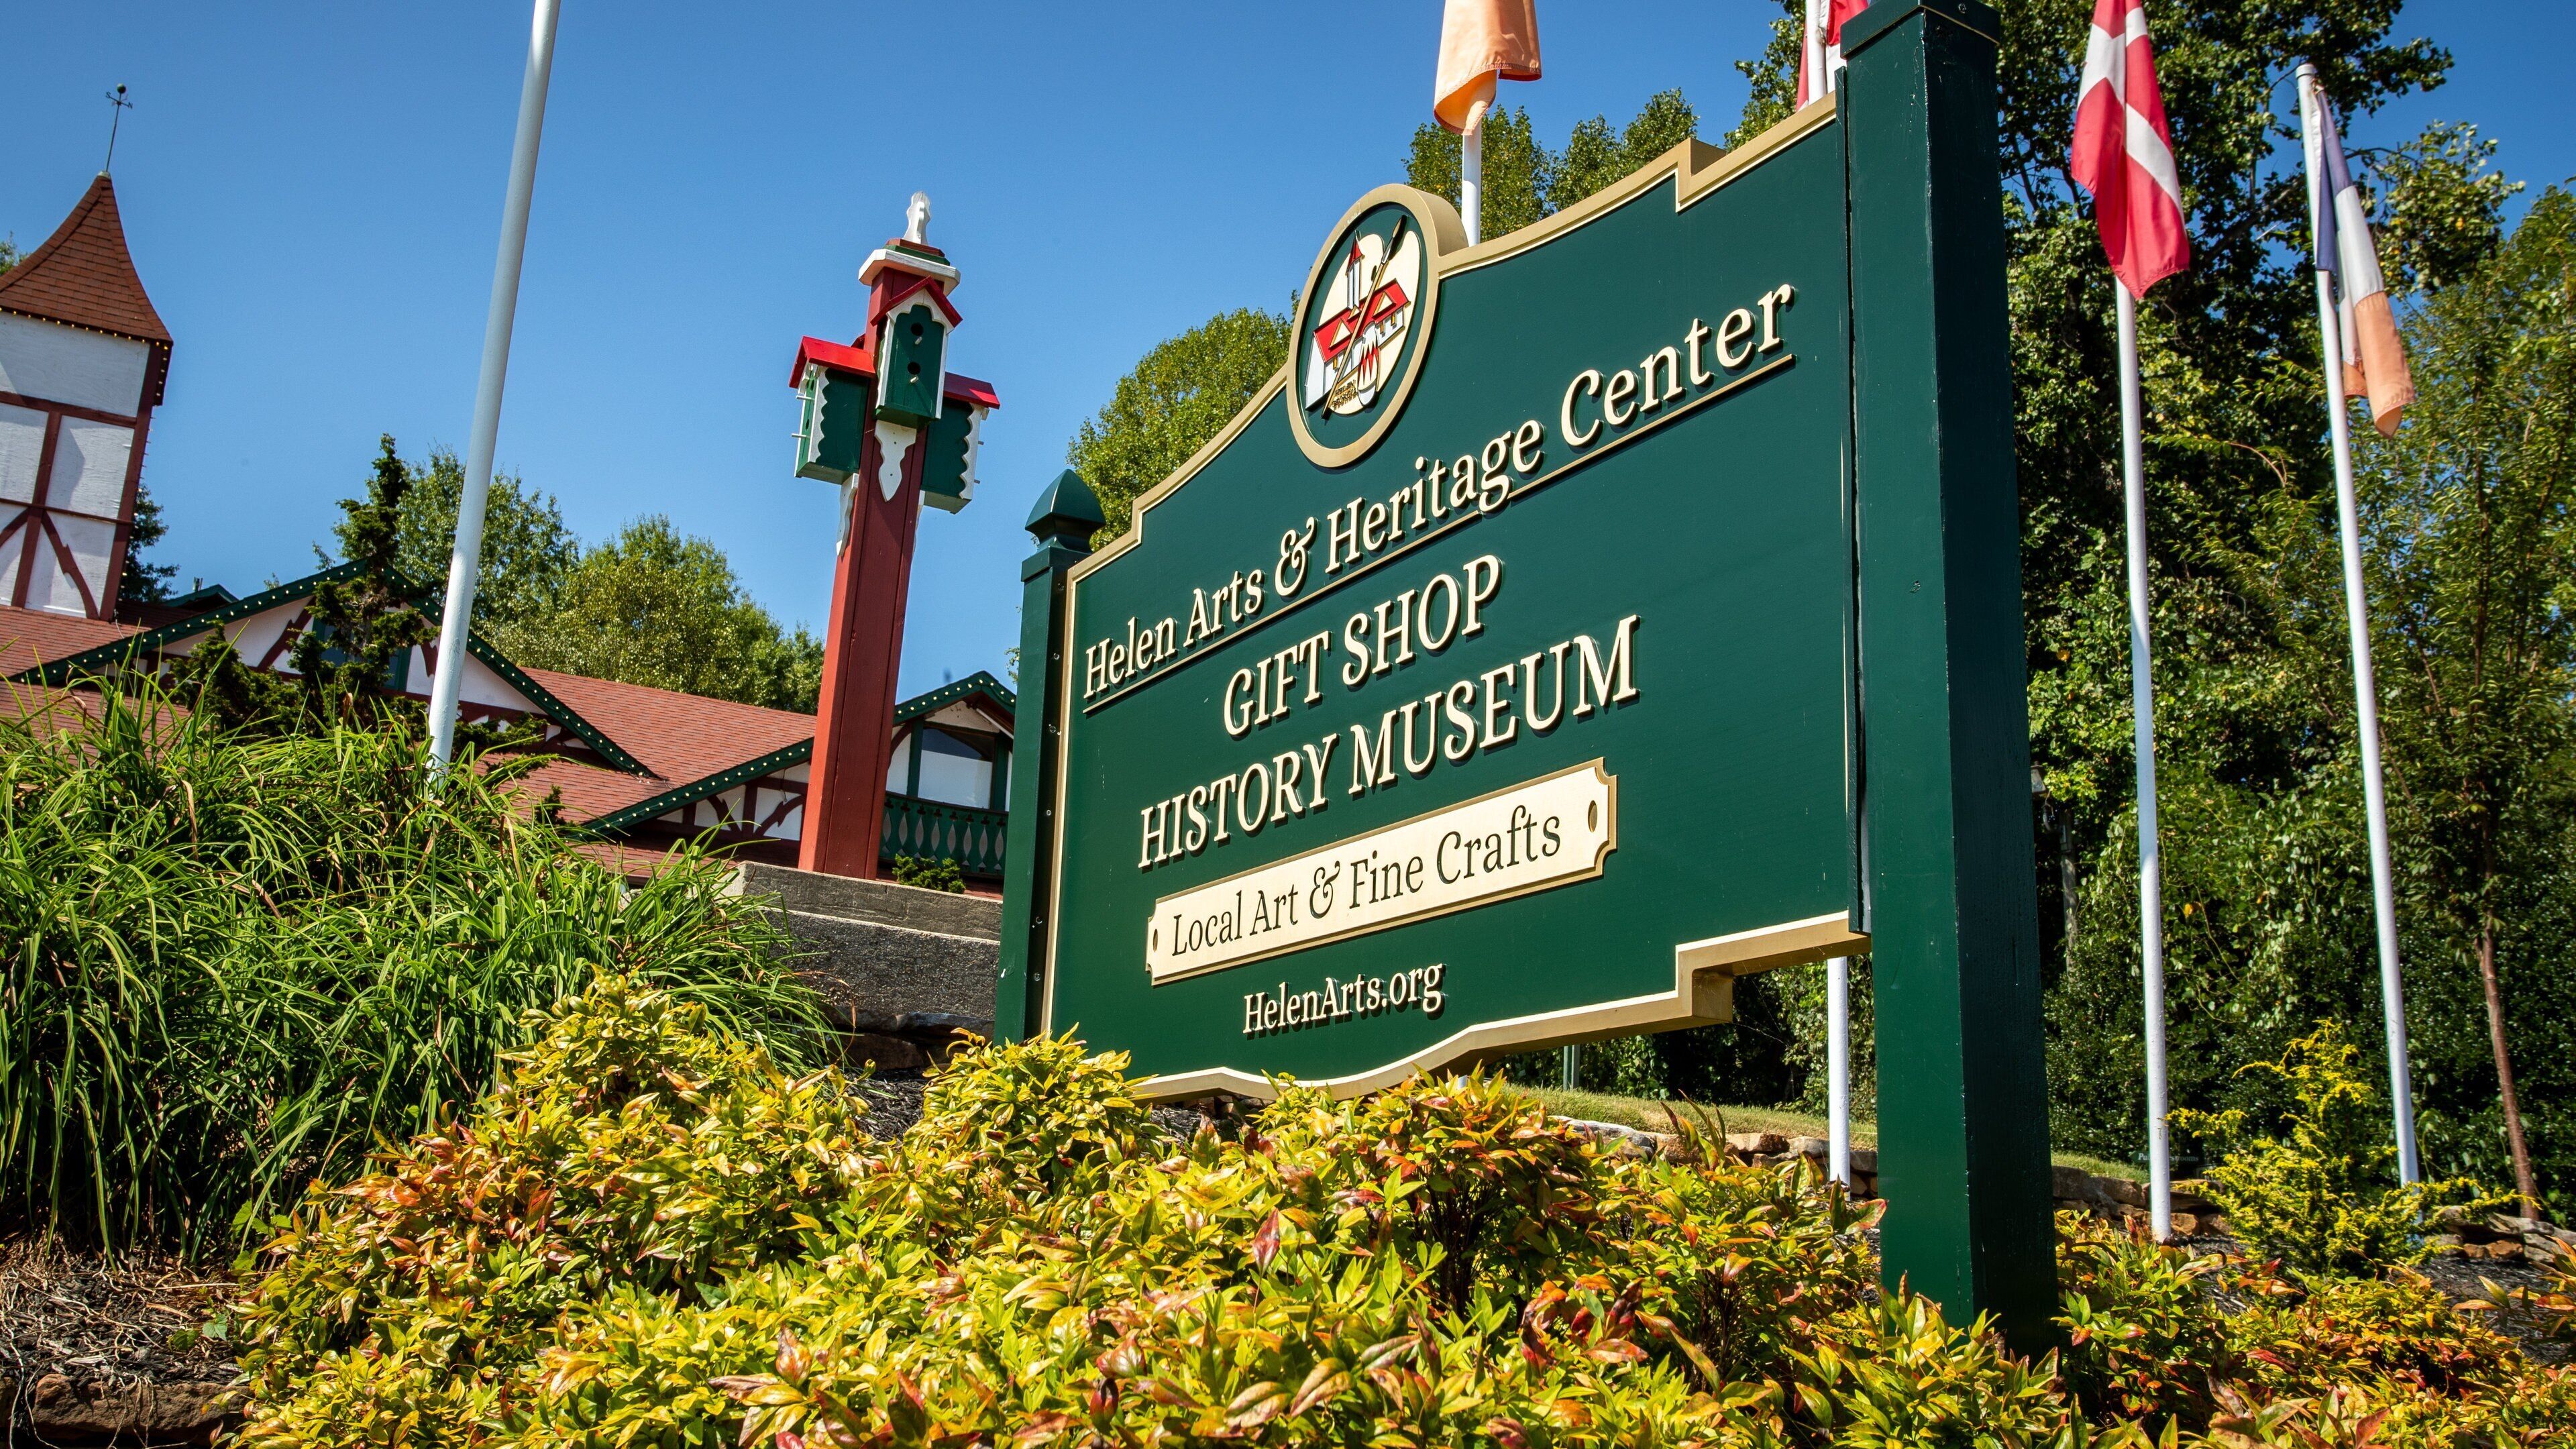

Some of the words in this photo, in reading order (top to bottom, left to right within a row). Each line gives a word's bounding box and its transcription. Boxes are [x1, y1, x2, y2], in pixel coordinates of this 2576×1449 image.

[1082, 617, 1176, 700] Helen
[1183, 569, 1264, 649] Arts
[1275, 517, 1316, 597] &
[1324, 419, 1542, 575] Heritage
[1560, 283, 1796, 447] Center
[1224, 631, 1330, 737] GIFT
[1342, 554, 1503, 686] SHOP
[1138, 733, 1339, 869] HISTORY
[1348, 614, 1638, 795] MUSEUM
[1172, 890, 1242, 956] Local
[1250, 883, 1299, 936] Art
[1309, 861, 1340, 919] &
[1349, 850, 1424, 909] Fine
[1436, 805, 1562, 885] Crafts
[1242, 963, 1446, 1034] HelenArts.org
